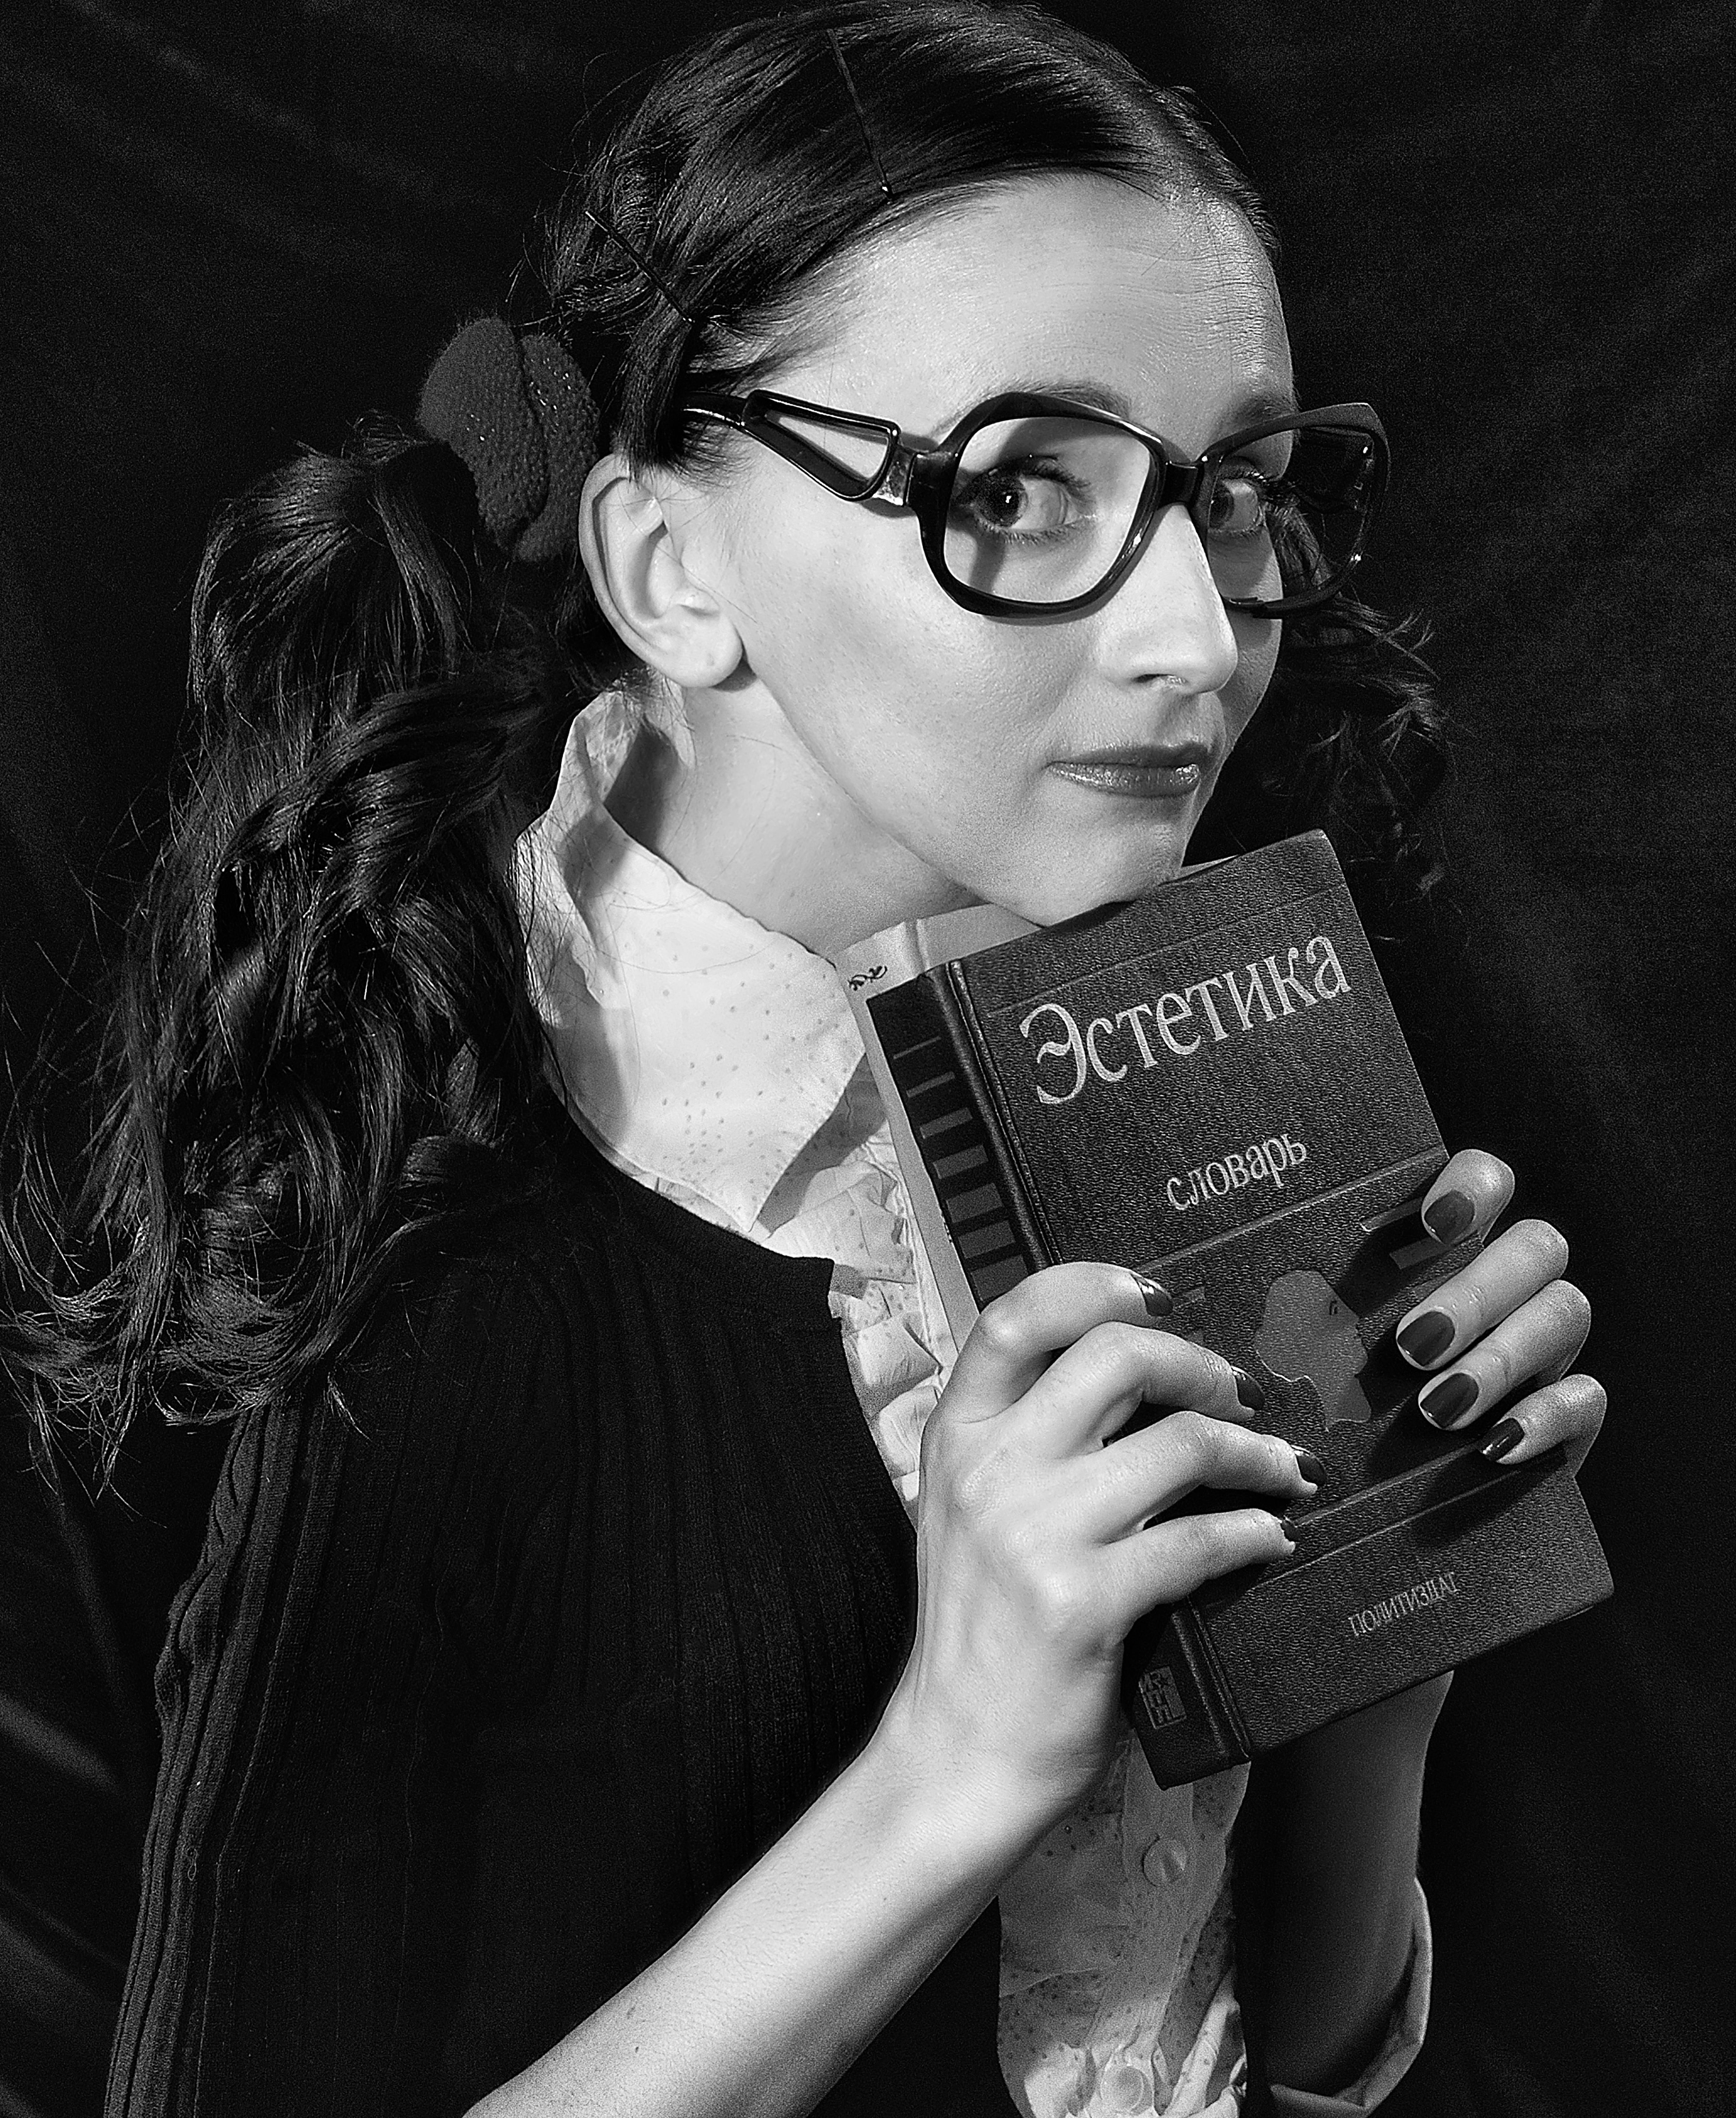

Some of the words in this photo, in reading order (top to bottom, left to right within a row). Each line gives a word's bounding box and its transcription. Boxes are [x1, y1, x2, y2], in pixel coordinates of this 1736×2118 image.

[1019, 935, 1352, 1104] Эстетика
[1167, 1133, 1306, 1210] словарь
[1348, 1572, 1458, 1636] ПОЛИТИЗДАТ
